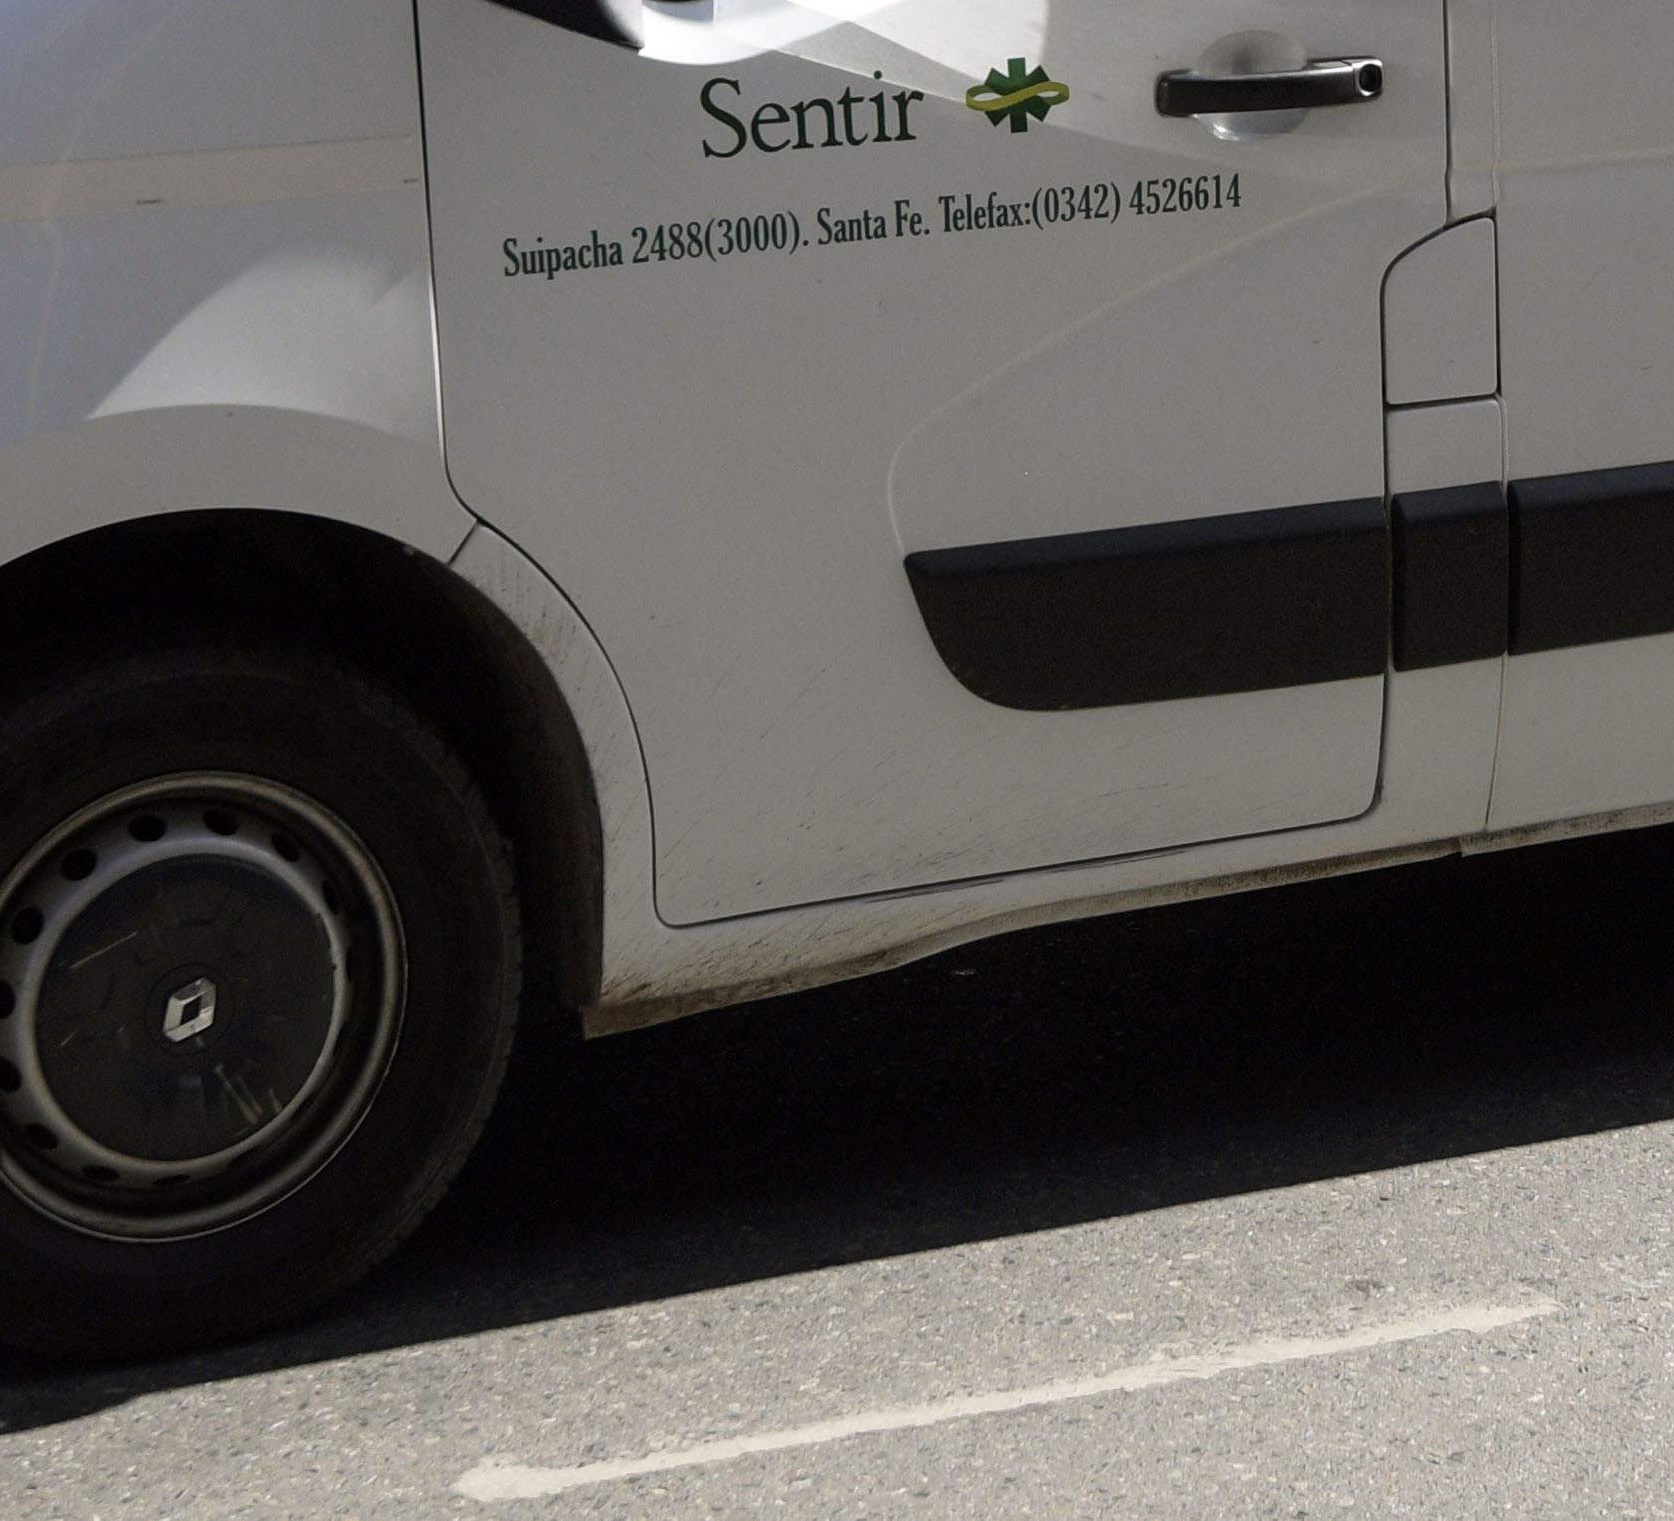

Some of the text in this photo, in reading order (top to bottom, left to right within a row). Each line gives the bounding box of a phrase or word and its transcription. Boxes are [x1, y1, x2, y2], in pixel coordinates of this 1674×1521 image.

[699, 70, 925, 159] Sentir
[502, 229, 624, 281] Suipacha
[631, 210, 809, 264] 2488(3000).
[816, 207, 888, 245] Santa
[893, 199, 930, 238] Fe.
[1128, 172, 1242, 216] 4526614
